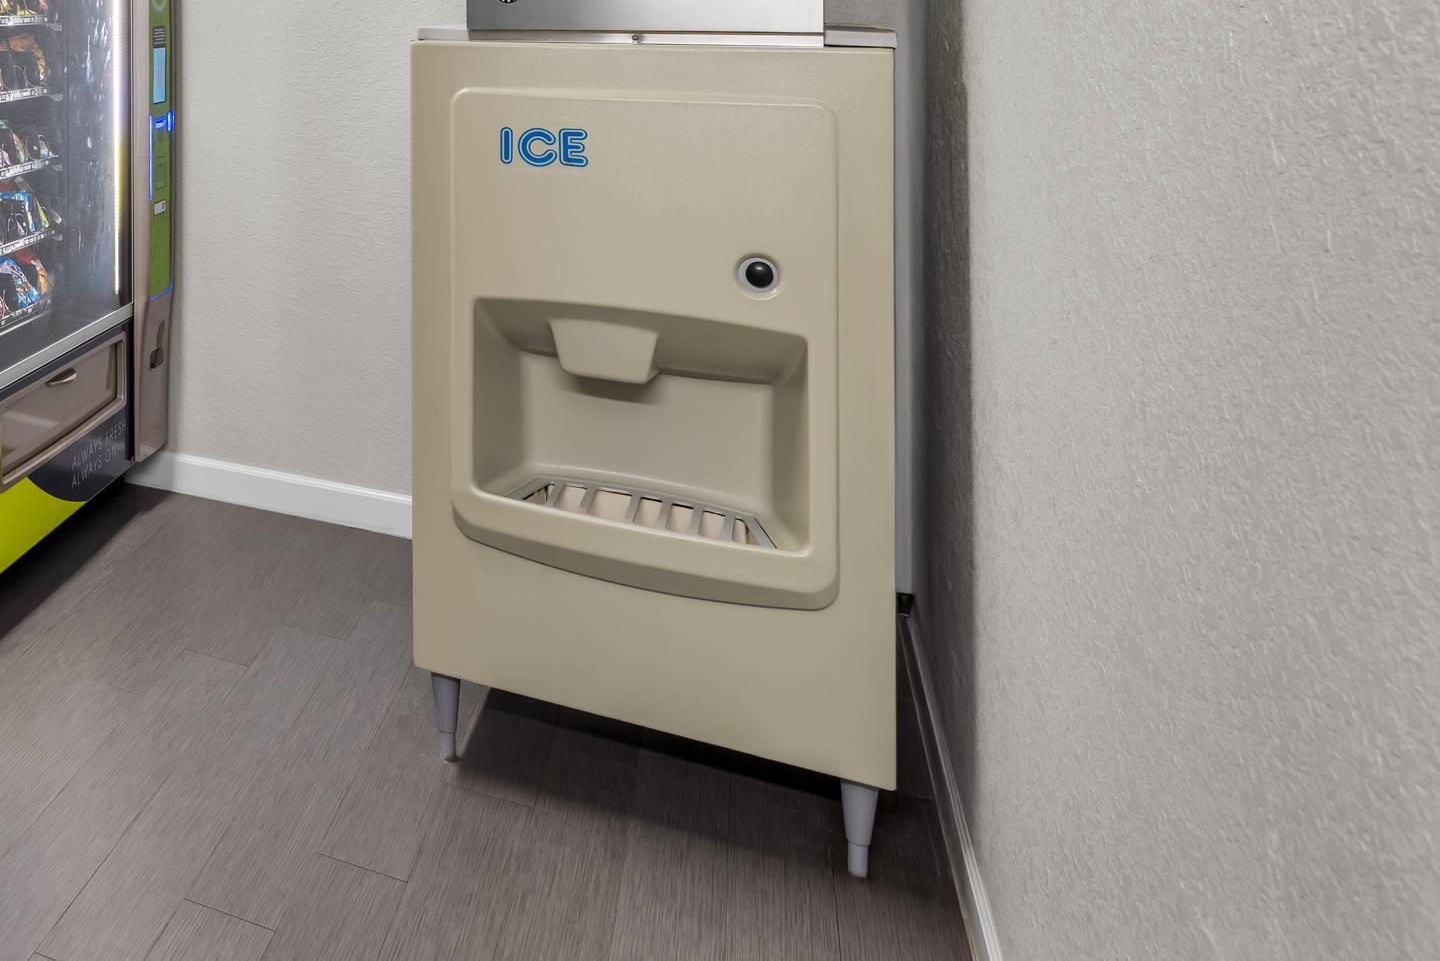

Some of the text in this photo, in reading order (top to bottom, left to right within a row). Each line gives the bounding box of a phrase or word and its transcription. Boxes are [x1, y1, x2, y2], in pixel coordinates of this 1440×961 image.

[500, 127, 588, 167] ICE
[71, 439, 103, 470] ALWAYS
[71, 445, 117, 489] ALWAYS ON
